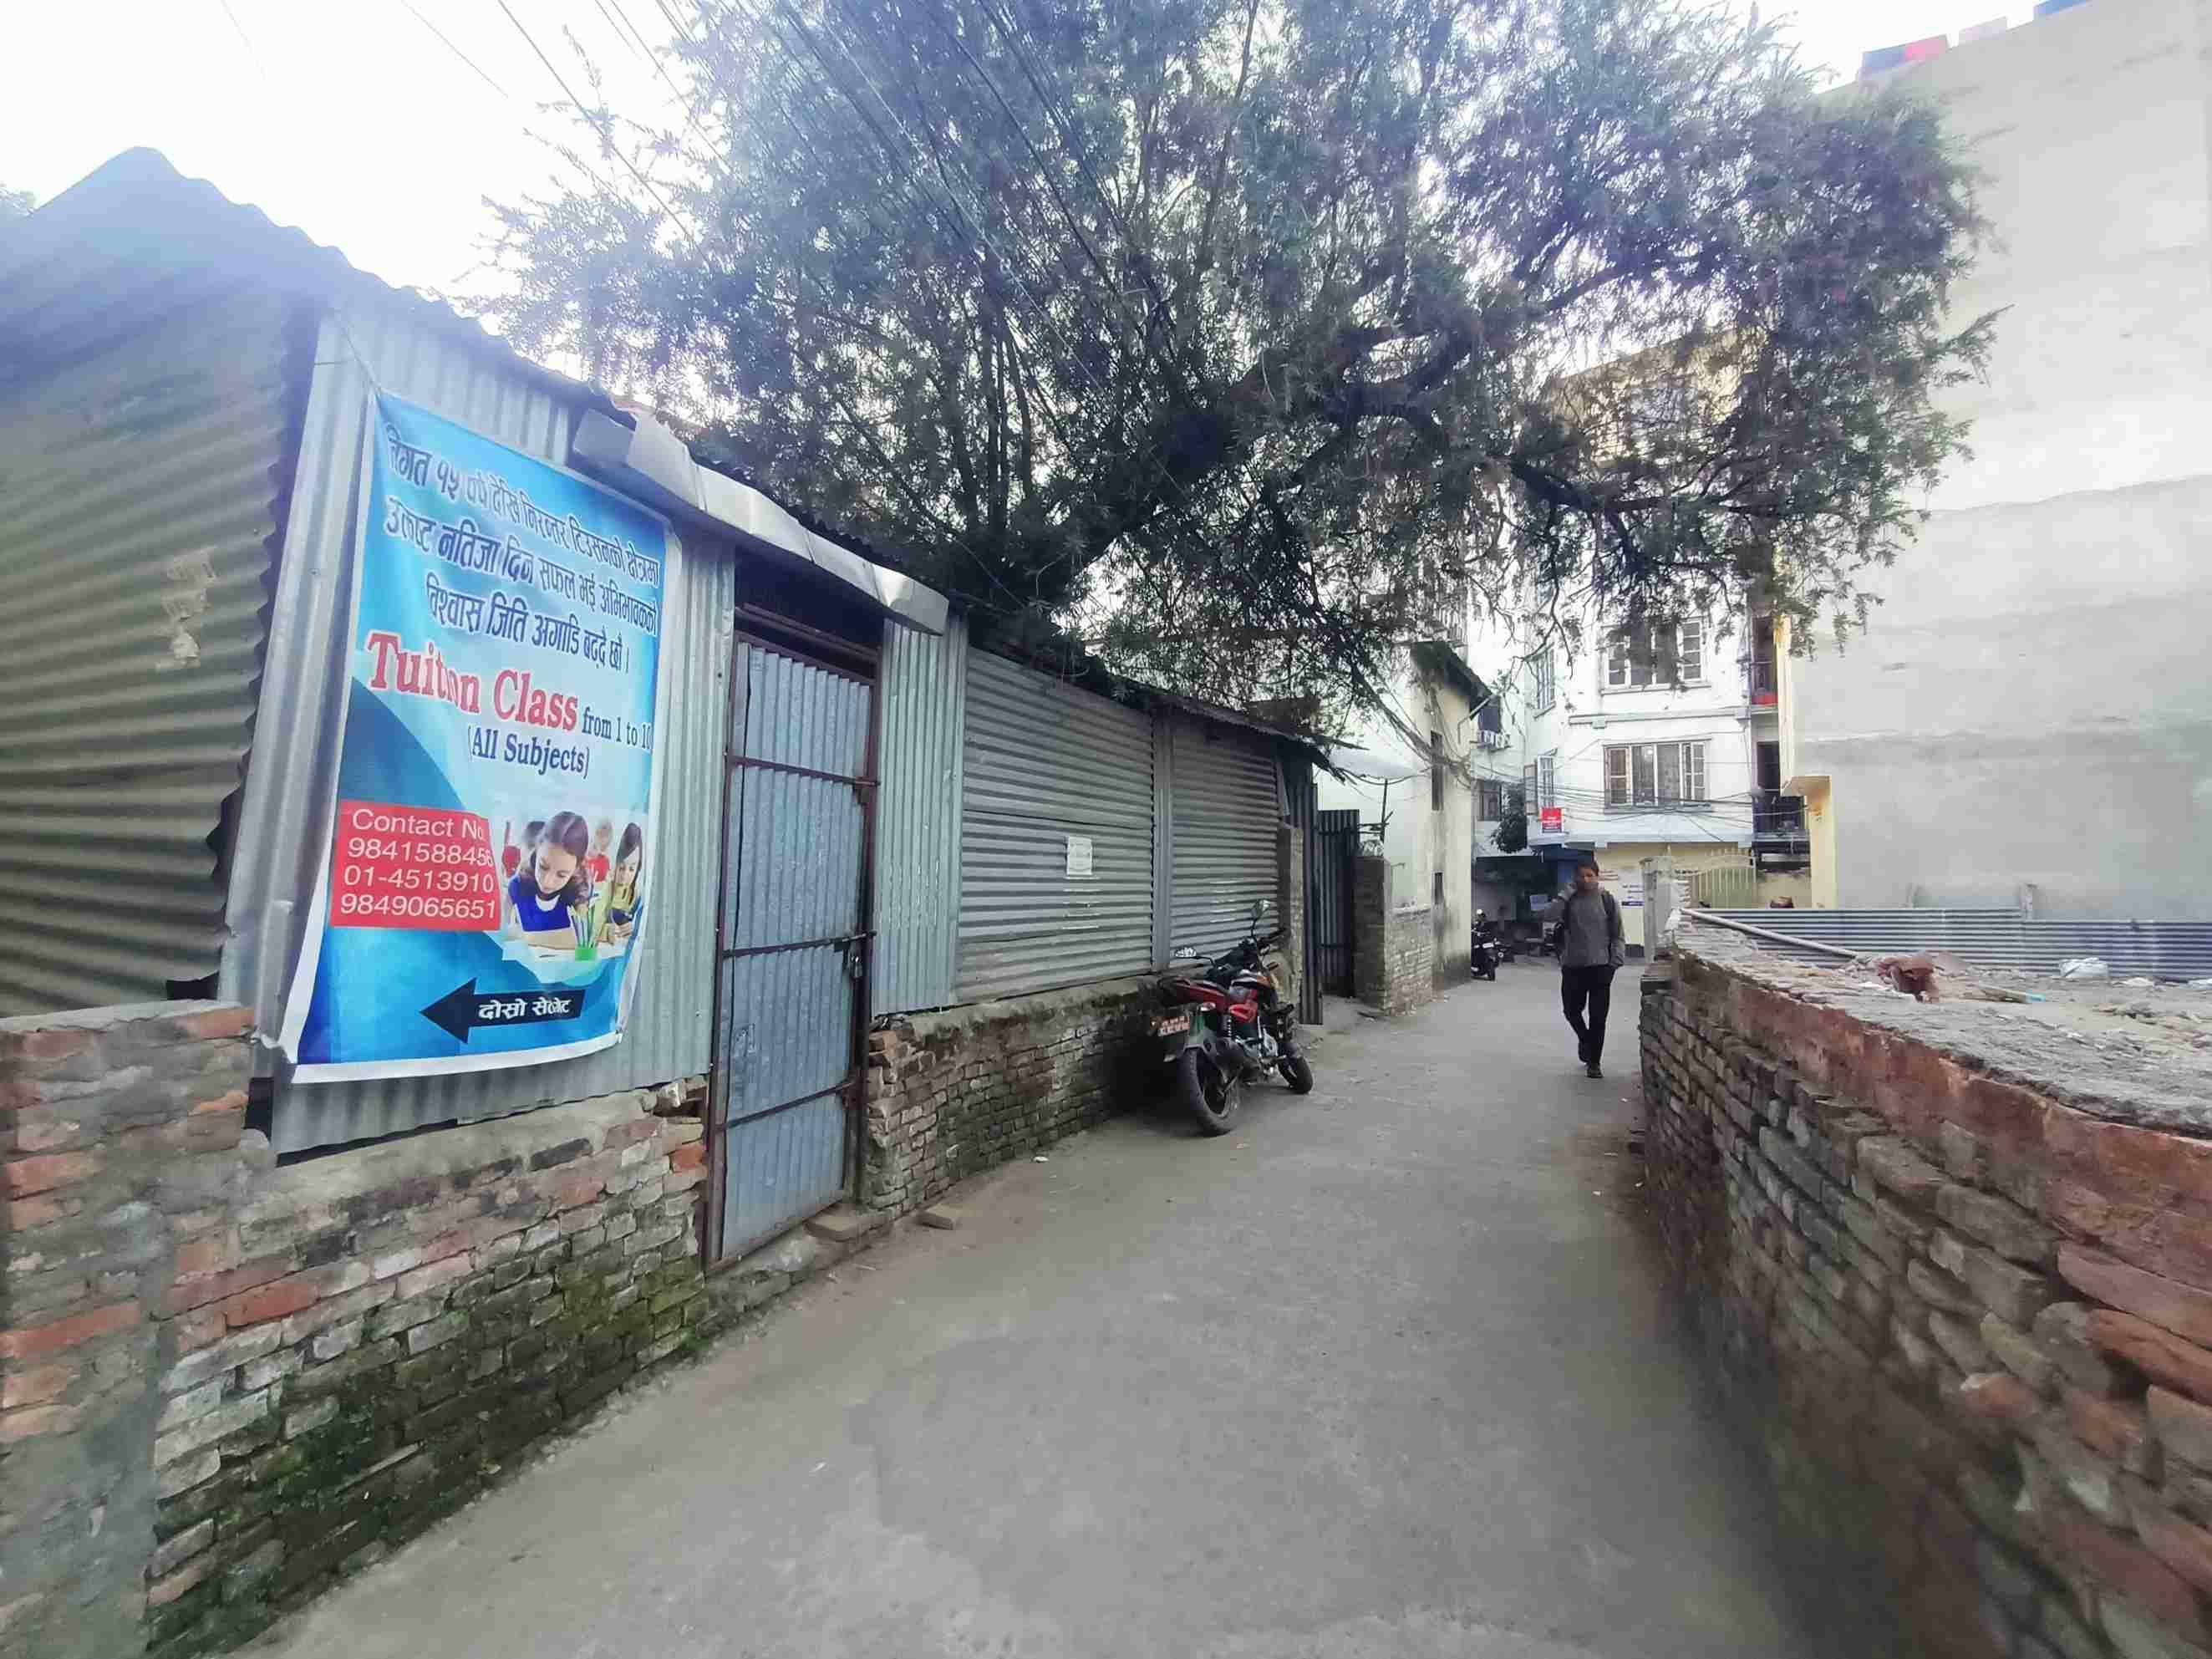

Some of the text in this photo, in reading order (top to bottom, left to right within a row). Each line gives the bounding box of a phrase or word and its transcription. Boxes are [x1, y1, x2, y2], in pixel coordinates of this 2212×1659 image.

[437, 461, 460, 500] १५
[438, 518, 501, 573] नतिजा
[539, 558, 576, 599] सफल
[486, 592, 530, 642] जिति
[531, 613, 580, 654] अगाडि
[494, 669, 578, 731] Class
[582, 706, 613, 740] from
[615, 716, 623, 743] 1
[627, 721, 638, 746] to
[468, 725, 590, 778] (All Subjects)
[352, 808, 455, 837] Contact
[343, 865, 495, 893] 01-4513910
[340, 893, 496, 919] 9849065651
